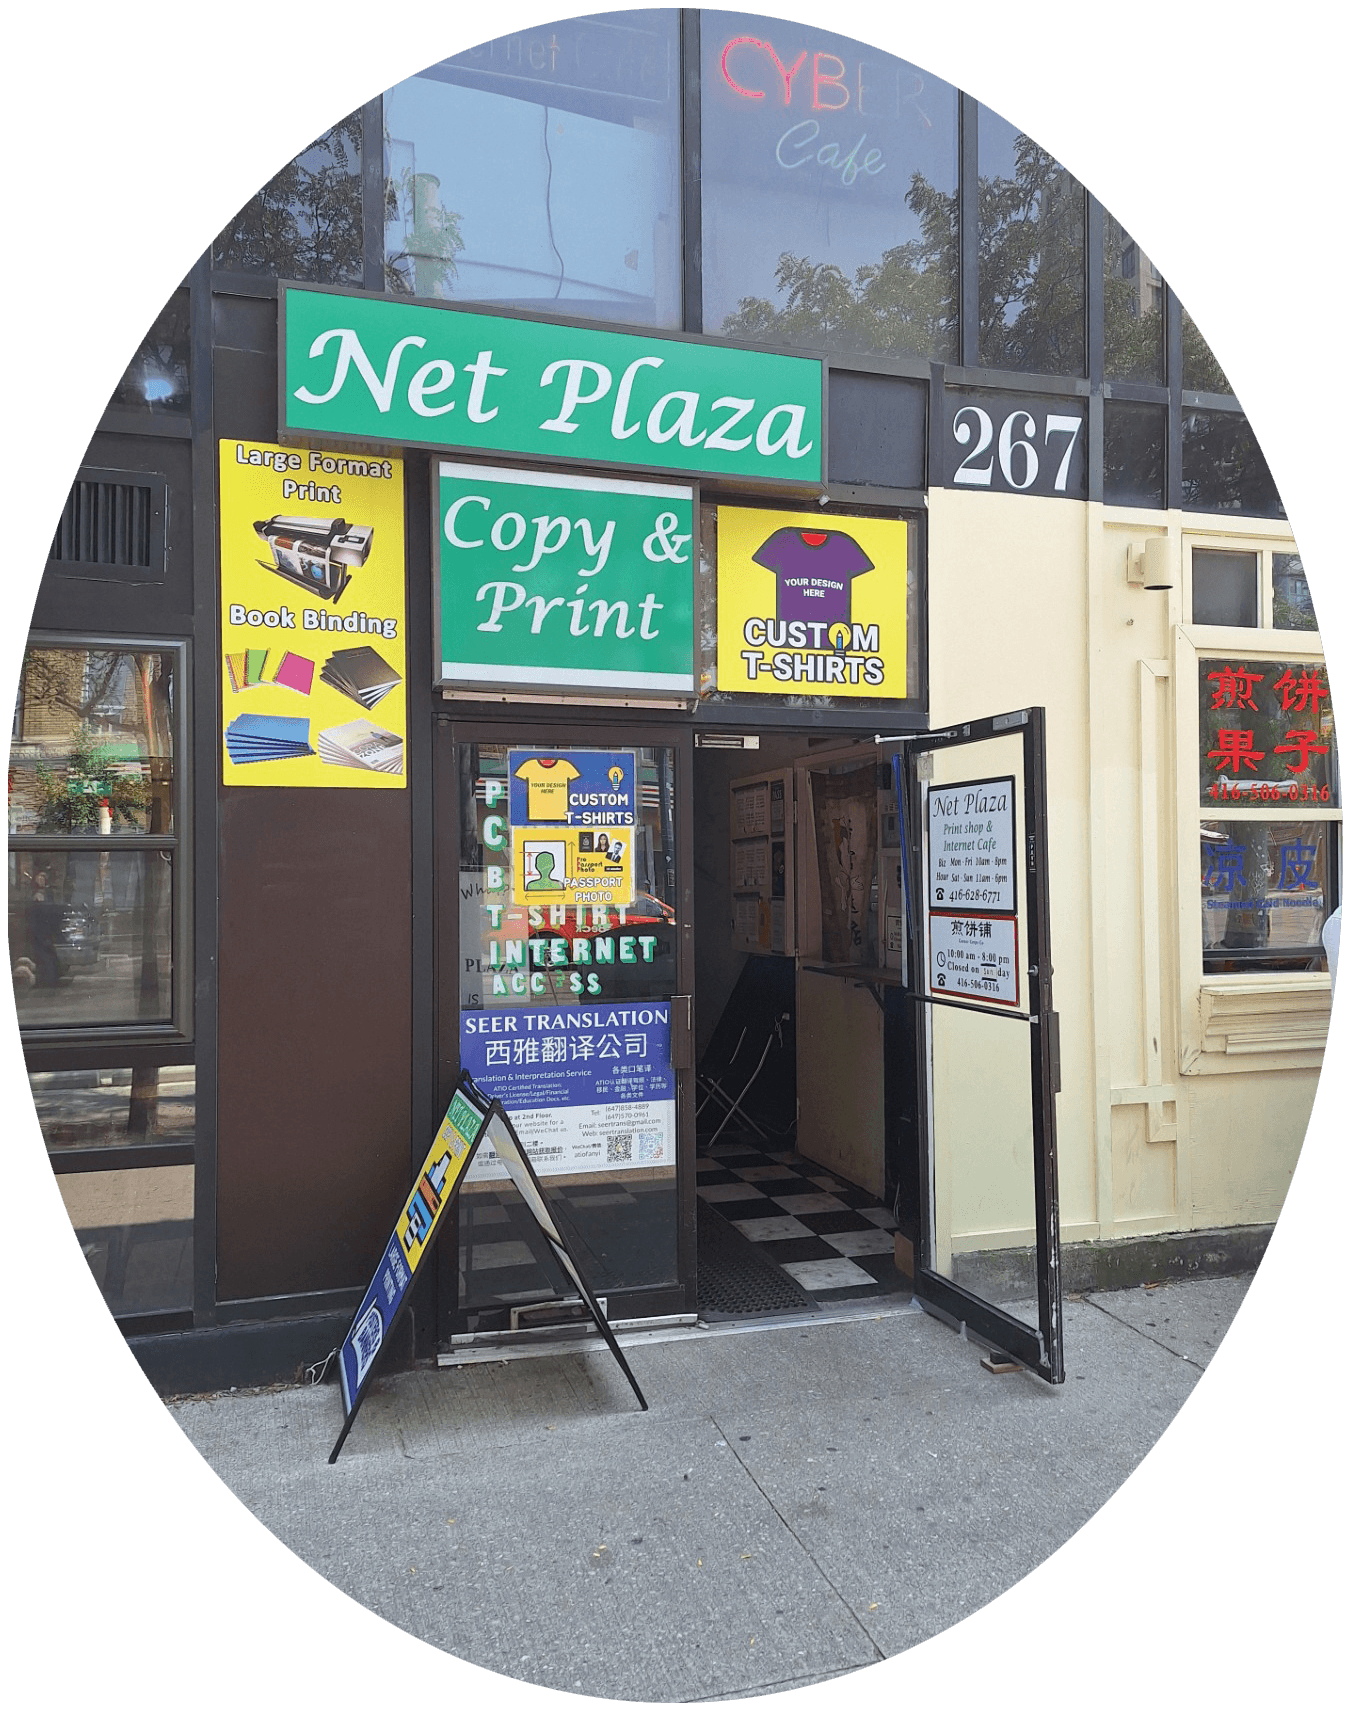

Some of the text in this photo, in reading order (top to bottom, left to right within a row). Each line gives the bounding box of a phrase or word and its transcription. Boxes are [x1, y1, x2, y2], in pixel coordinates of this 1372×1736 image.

[721, 36, 932, 128] CYBER
[776, 118, 886, 185] Cafe
[294, 328, 814, 459] Net Plaza
[953, 406, 1082, 491] 267
[236, 443, 393, 479] Large Format
[283, 479, 341, 503] Print
[444, 495, 690, 577] Copy &
[784, 577, 844, 591] YOUR DESIGN
[803, 588, 826, 598] HERE
[230, 604, 398, 639] Book Binding
[476, 581, 663, 640] Print
[744, 617, 880, 653] CUSTOM
[741, 650, 885, 686] T-SHIRTS
[1207, 665, 1329, 714] 煎饼
[1207, 729, 1329, 773] 果子
[568, 793, 629, 806] CUSTOM
[932, 788, 1008, 818] Net Plaza
[1209, 783, 1330, 801] 416-506-0316
[564, 810, 634, 825] T-SHIRTS
[943, 820, 993, 836] Print shop &
[943, 837, 997, 853] Internet Cafe
[938, 858, 947, 867] Biz
[950, 857, 961, 867] Mon
[965, 857, 973, 866] Fri
[1203, 838, 1318, 892] 凉皮
[564, 877, 624, 889] PASSPORT
[936, 872, 949, 881] Hour
[951, 873, 960, 883] Sat
[963, 873, 973, 883] Sun
[975, 873, 991, 883] 11am
[994, 873, 1008, 885] 6pm
[575, 890, 613, 903] PHOTO
[949, 888, 1001, 904] 416-628-6771
[487, 904, 629, 932] T-SHIRT
[951, 919, 993, 939] 煎饼铺
[490, 936, 658, 968] INTERNET
[947, 949, 964, 959] 10:00
[981, 951, 996, 963] 8:00
[998, 955, 1010, 966] pm
[947, 960, 969, 973] Closed
[970, 966, 980, 974] on
[957, 977, 1000, 993] 416-506-0316
[465, 1009, 669, 1034] SEER TRANSLATION
[484, 1033, 647, 1067] 西雅翻译公司
[472, 1069, 592, 1083] ranslation & Interpretation Service
[598, 1118, 662, 1129] seertrans@gmail.com
